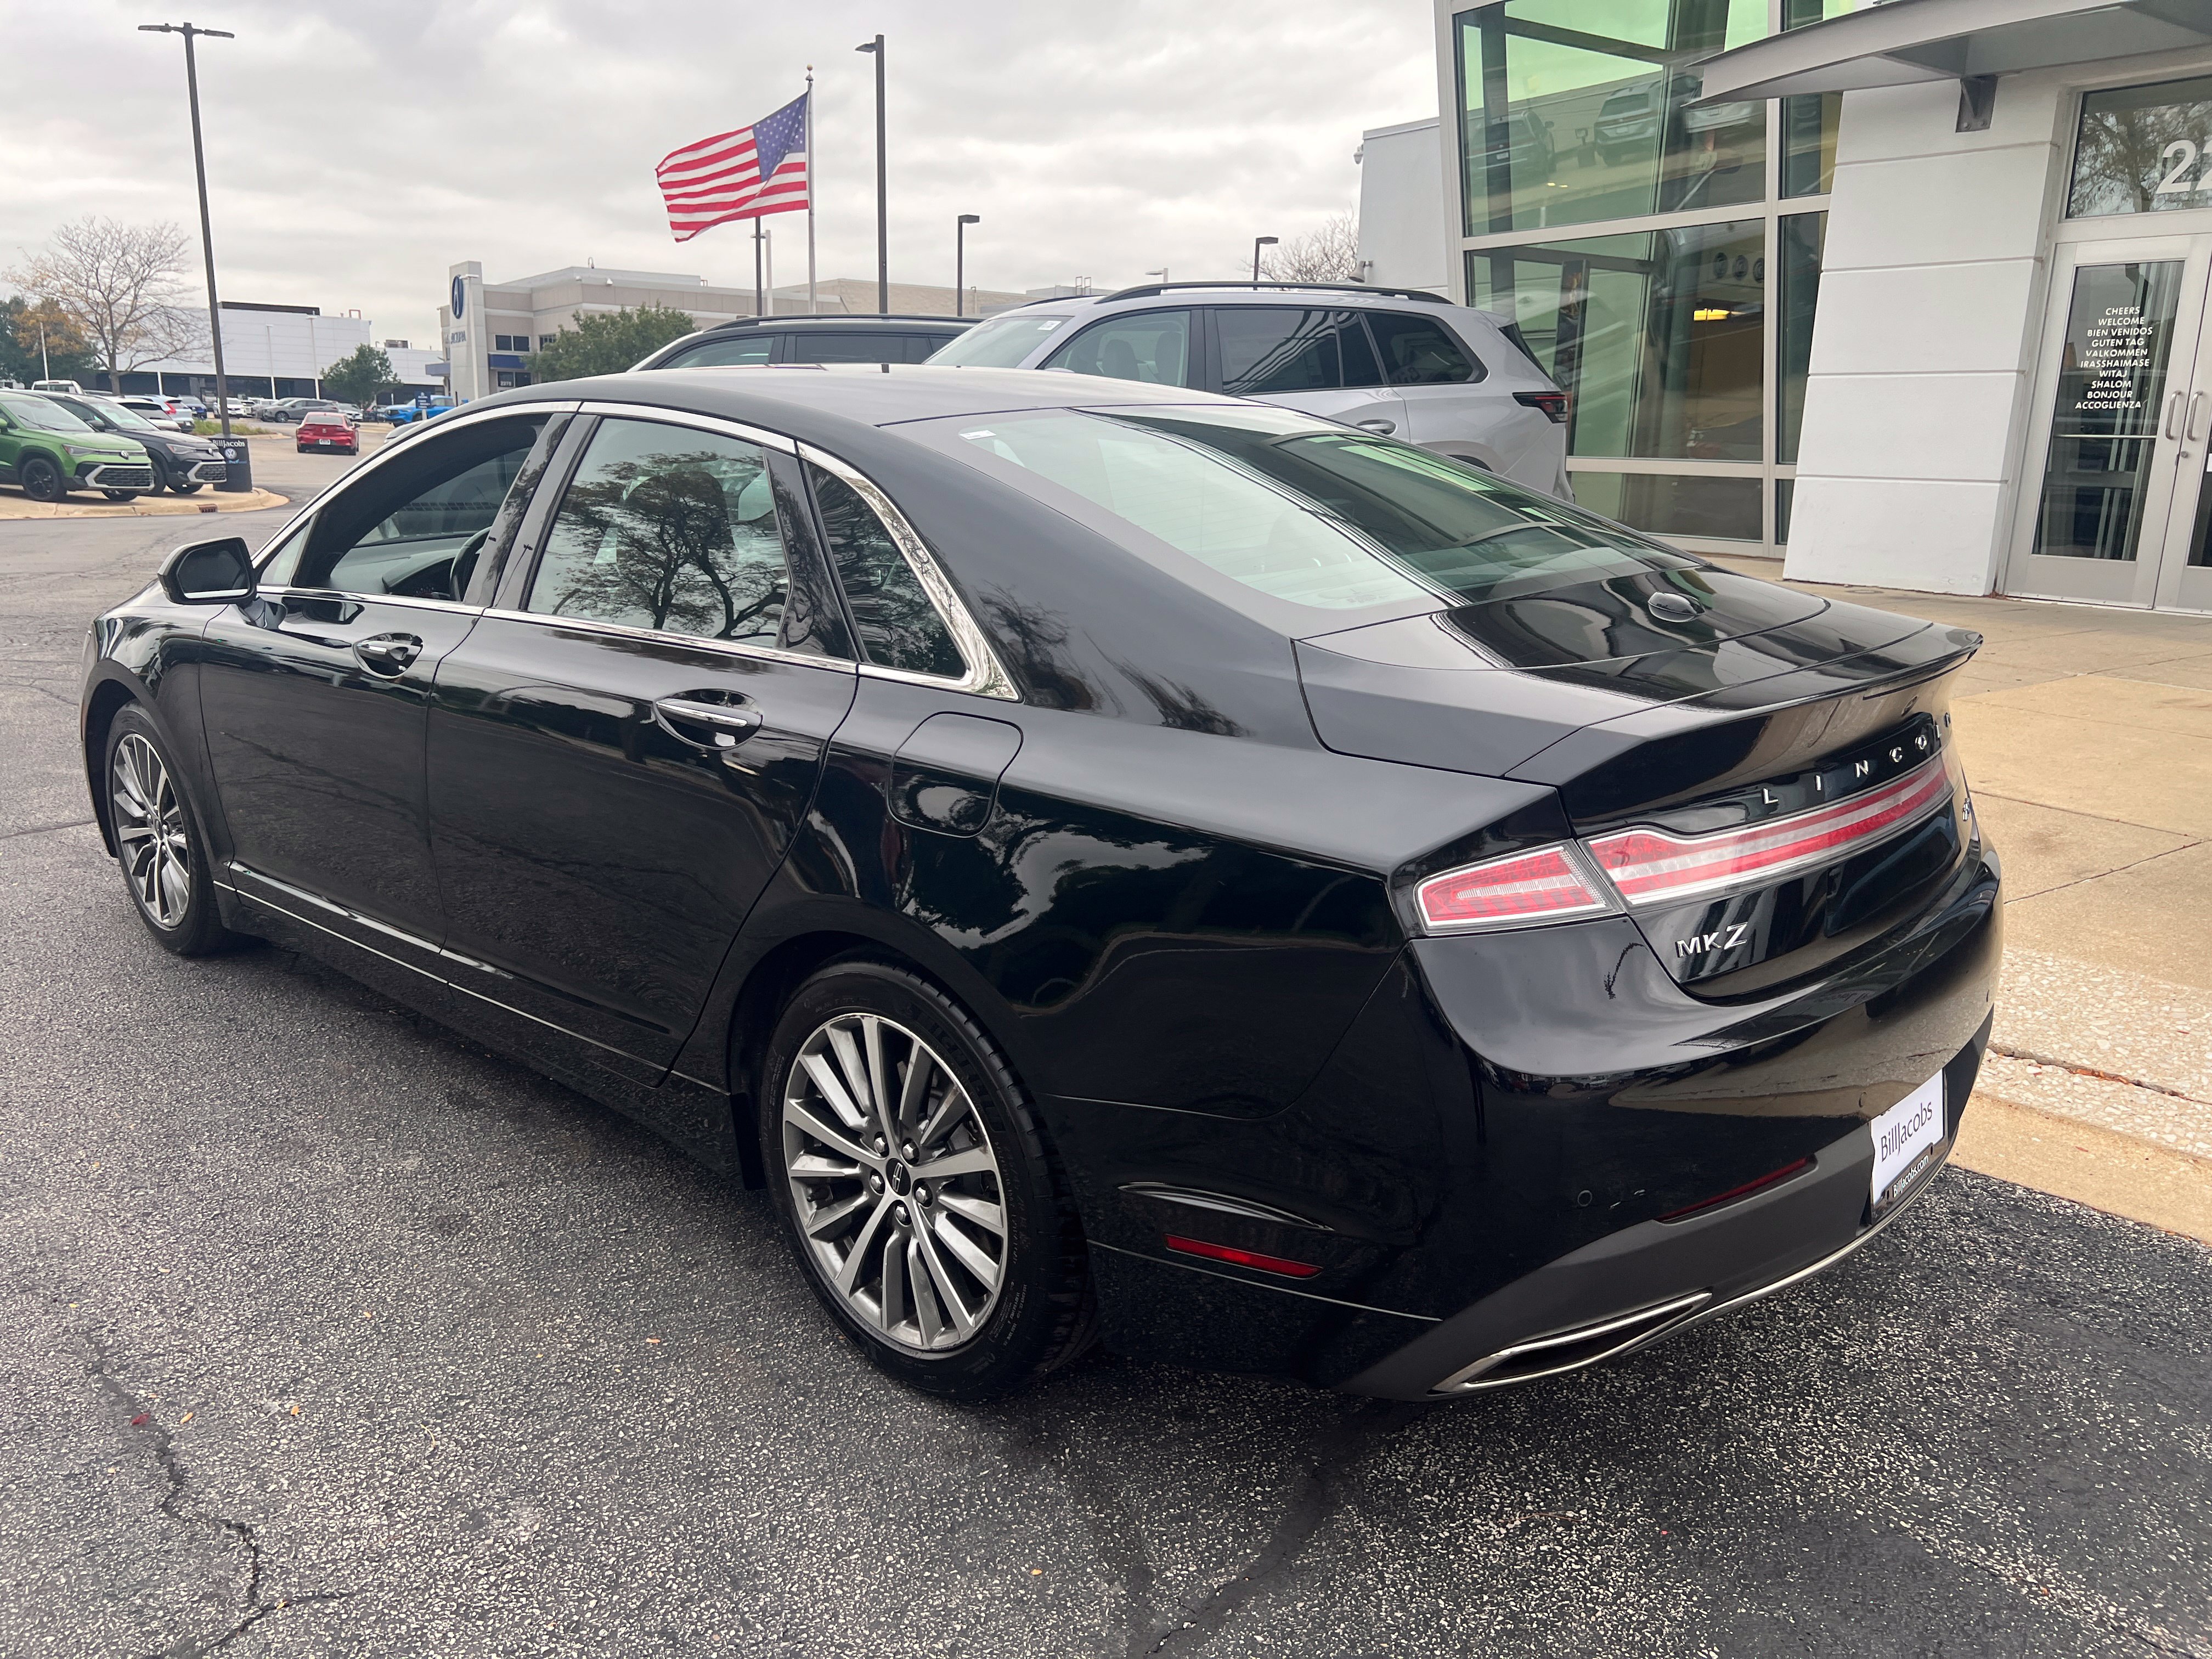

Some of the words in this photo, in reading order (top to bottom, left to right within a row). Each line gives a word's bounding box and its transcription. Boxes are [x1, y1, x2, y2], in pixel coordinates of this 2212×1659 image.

[2106, 307, 2140, 315] CHEERS
[2098, 317, 2145, 326] WELCOME
[2111, 327, 2153, 336] VENIDOS
[2092, 339, 2123, 347] GUTEN
[2125, 338, 2145, 346] TAG
[2086, 348, 2148, 357] VALKOMMEN
[2080, 359, 2149, 368] IRASSHAIMASE
[2091, 380, 2131, 389] SHALOM
[2075, 401, 2141, 409] ACCOGLIENZA
[1675, 921, 1748, 958] MKZ
